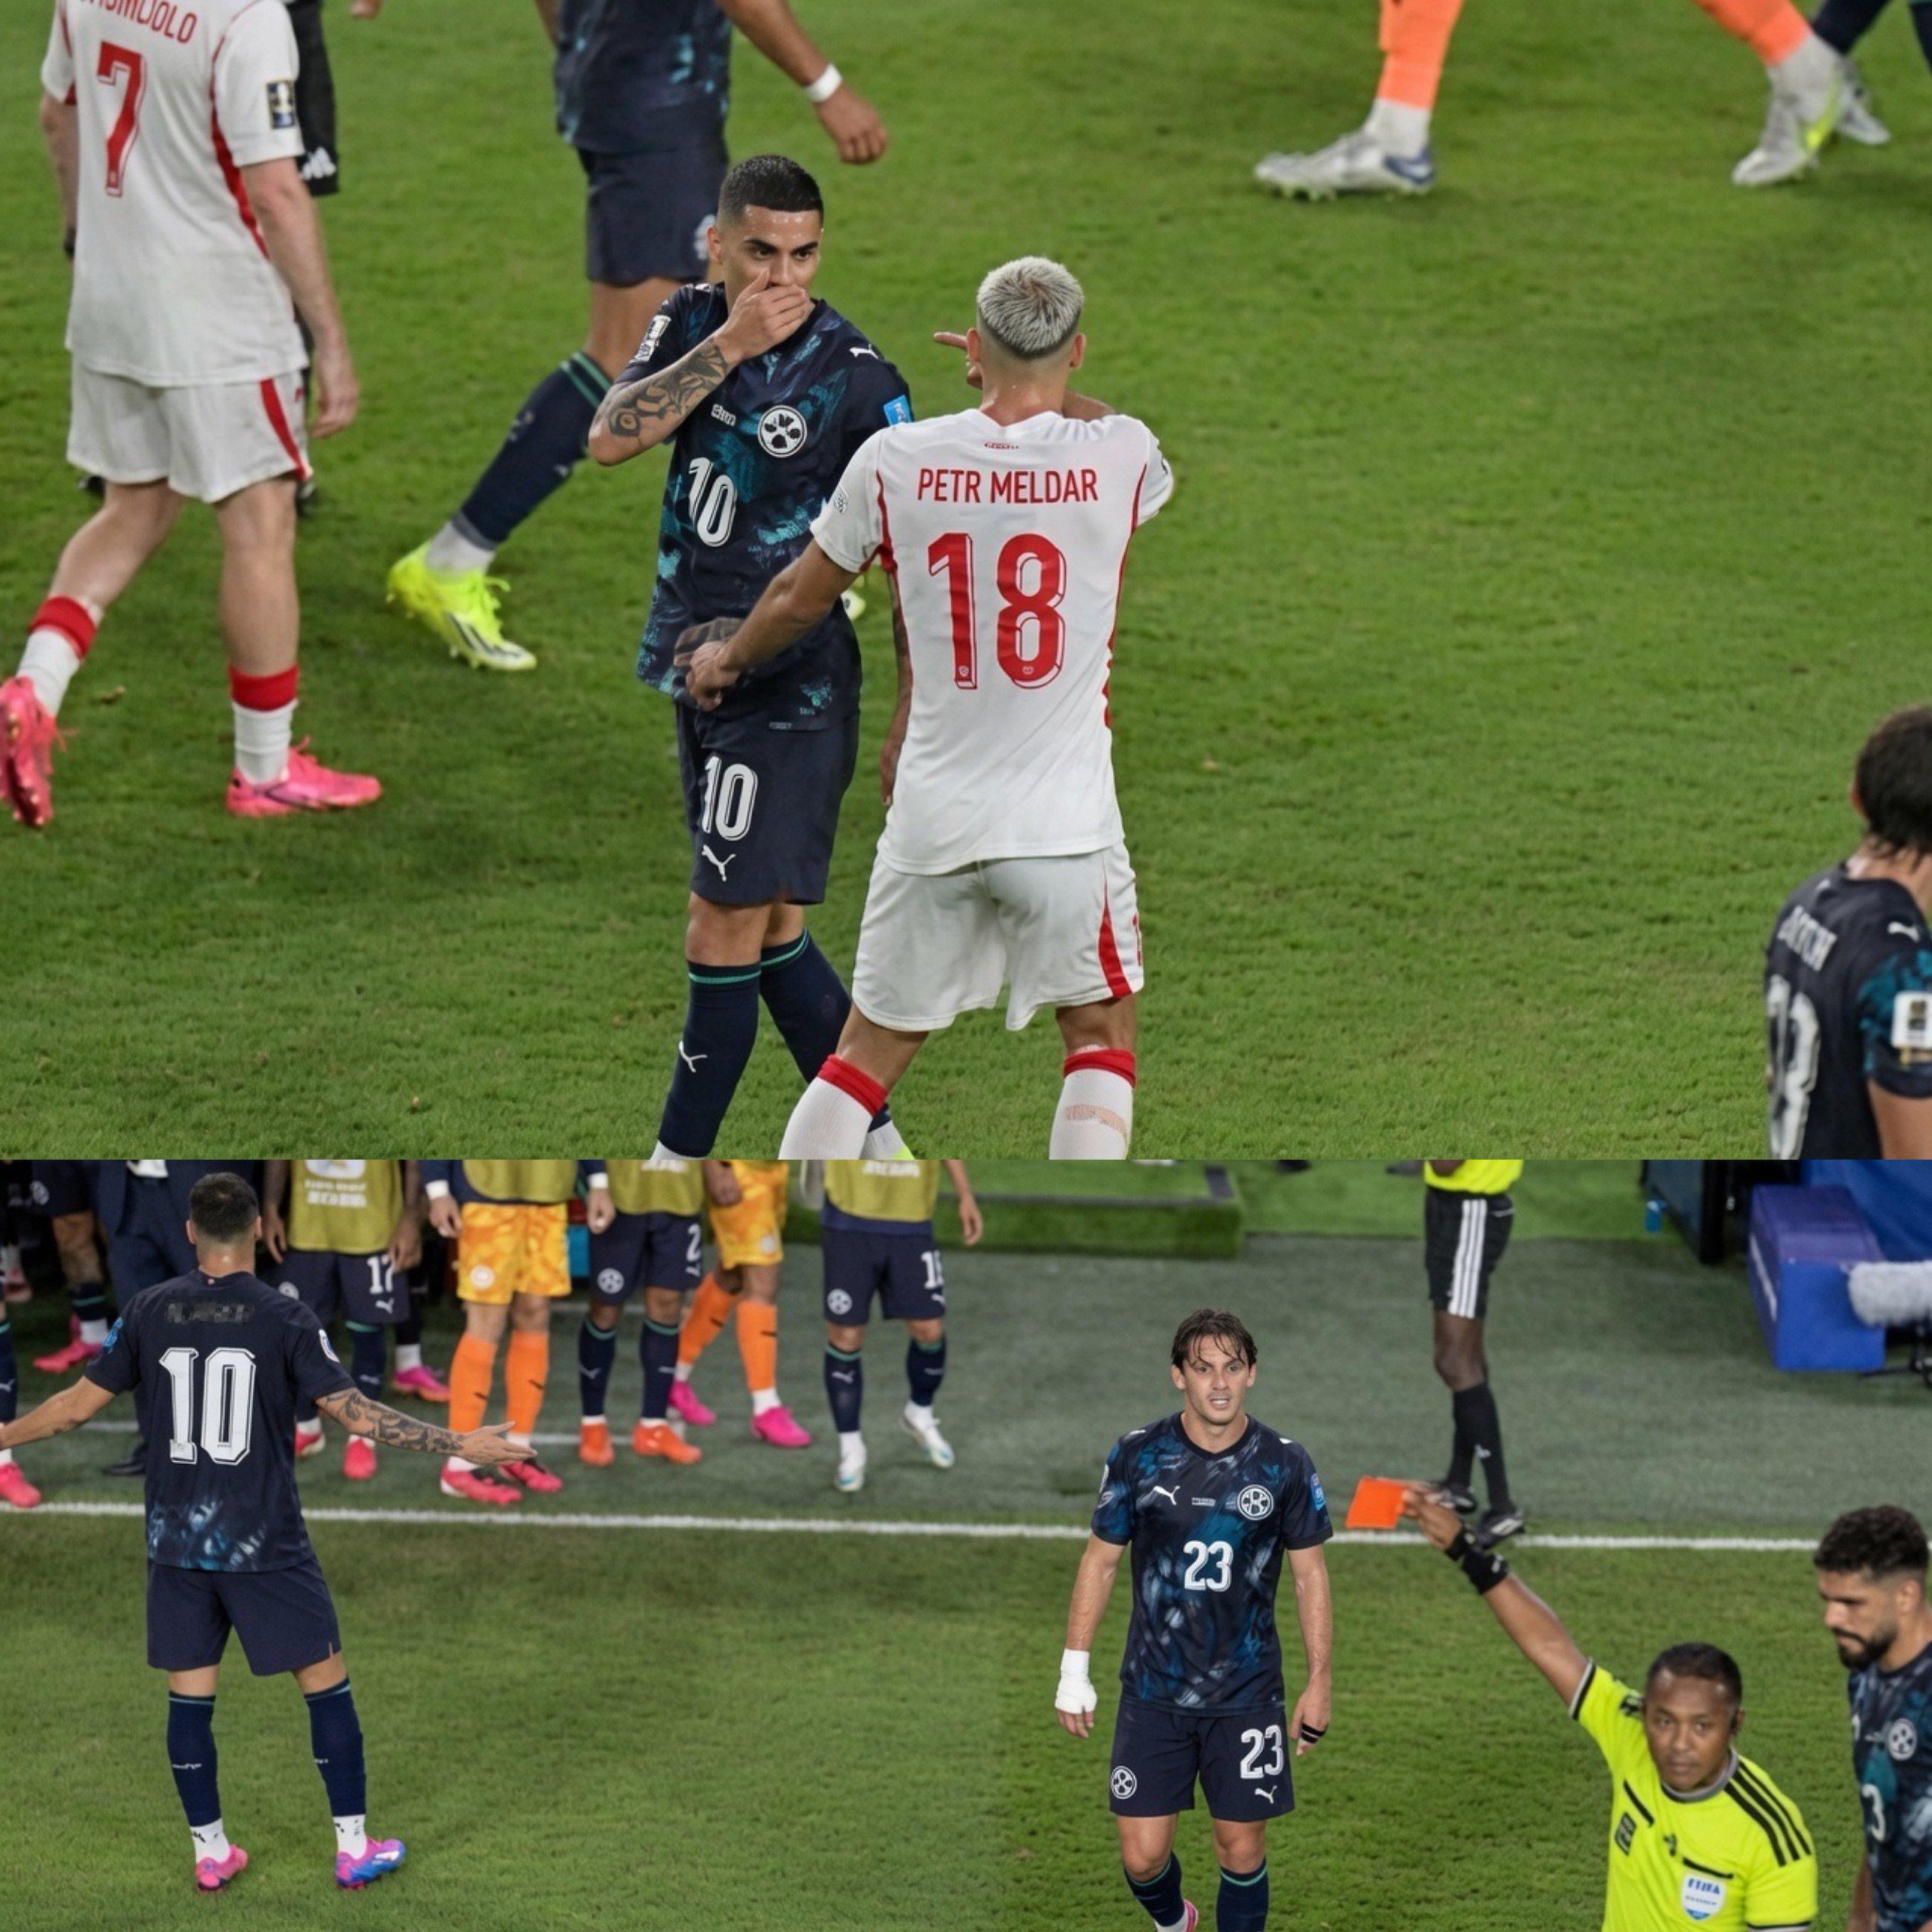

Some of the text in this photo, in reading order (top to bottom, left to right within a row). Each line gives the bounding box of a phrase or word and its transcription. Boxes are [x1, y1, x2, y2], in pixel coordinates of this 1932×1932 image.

[97, 41, 146, 197] 7
[688, 457, 737, 547] 10
[918, 468, 1098, 503] PETR MELDAR
[928, 533, 1066, 689] 18
[701, 756, 758, 841] 10
[159, 1347, 256, 1465] 10
[1183, 1541, 1233, 1591] 23
[1239, 1724, 1284, 1779] 23
